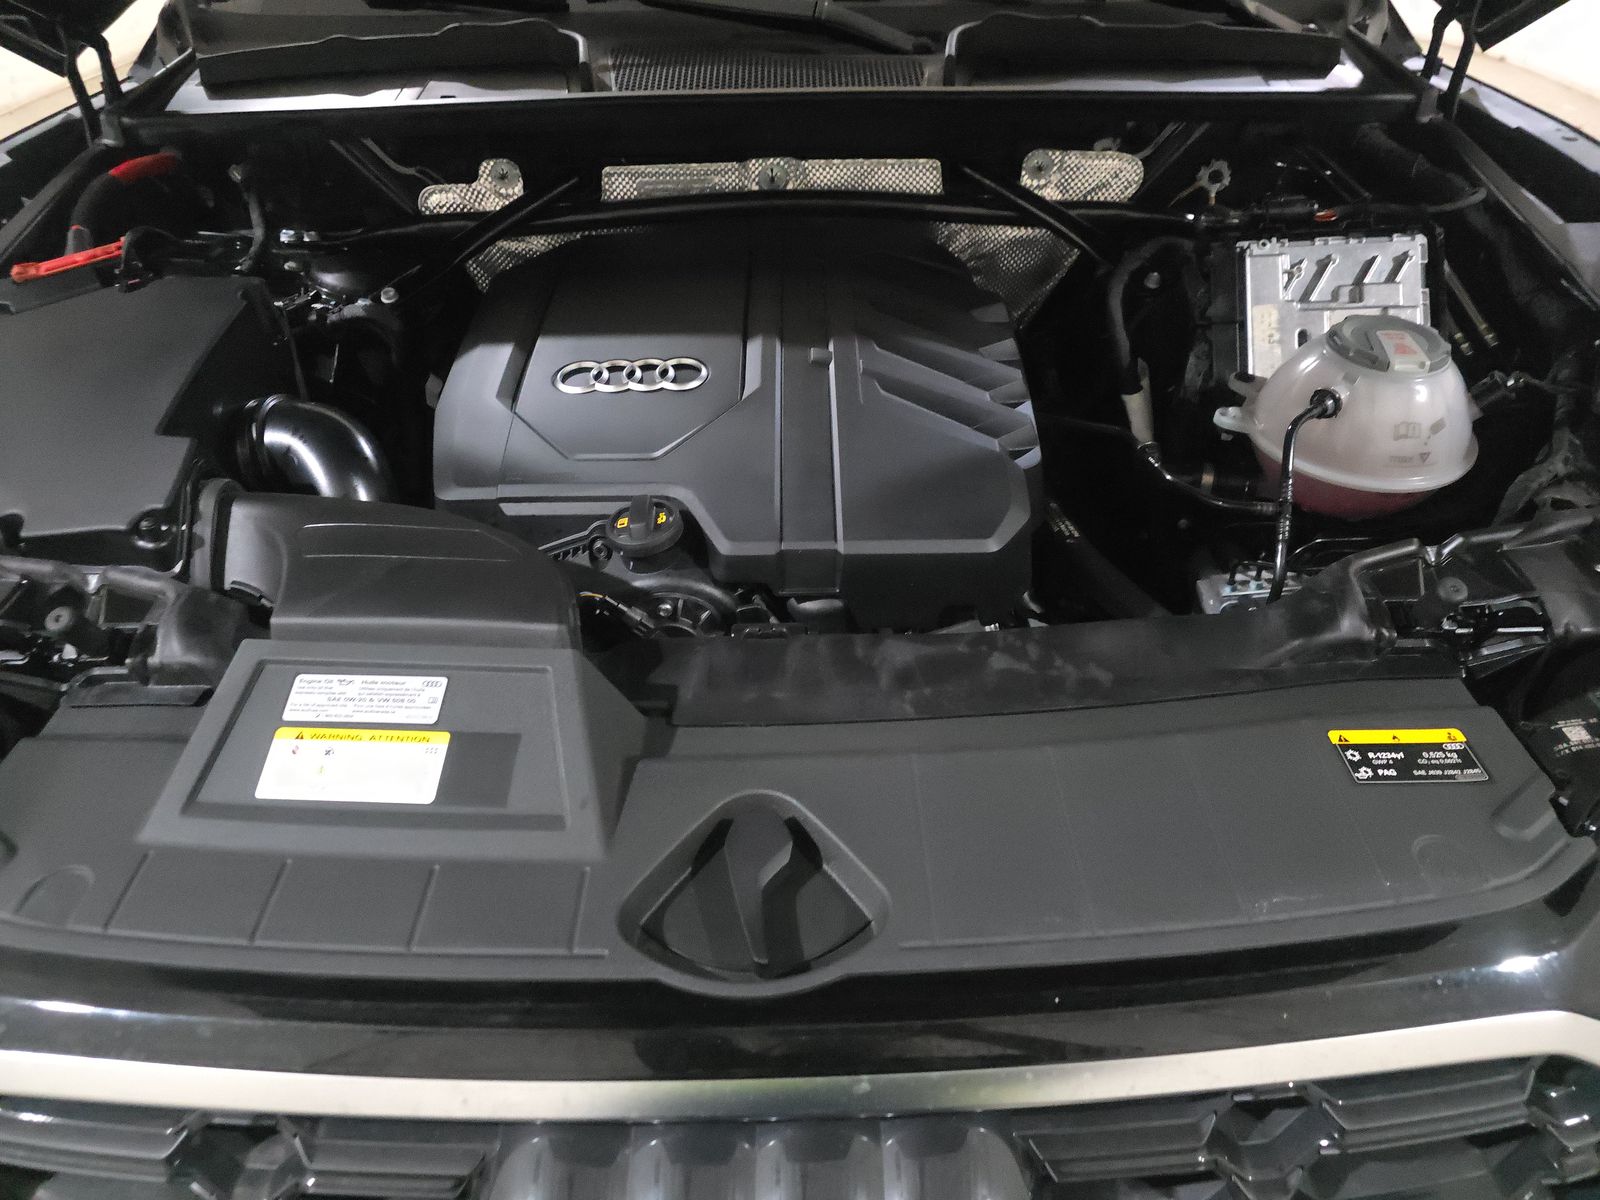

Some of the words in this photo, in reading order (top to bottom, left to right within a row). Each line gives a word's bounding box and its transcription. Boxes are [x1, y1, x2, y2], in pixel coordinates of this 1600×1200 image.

[310, 733, 363, 741] WARNING
[369, 734, 431, 743] ATTENTION
[1446, 751, 1458, 759] kg
[1377, 768, 1397, 776] PAG
